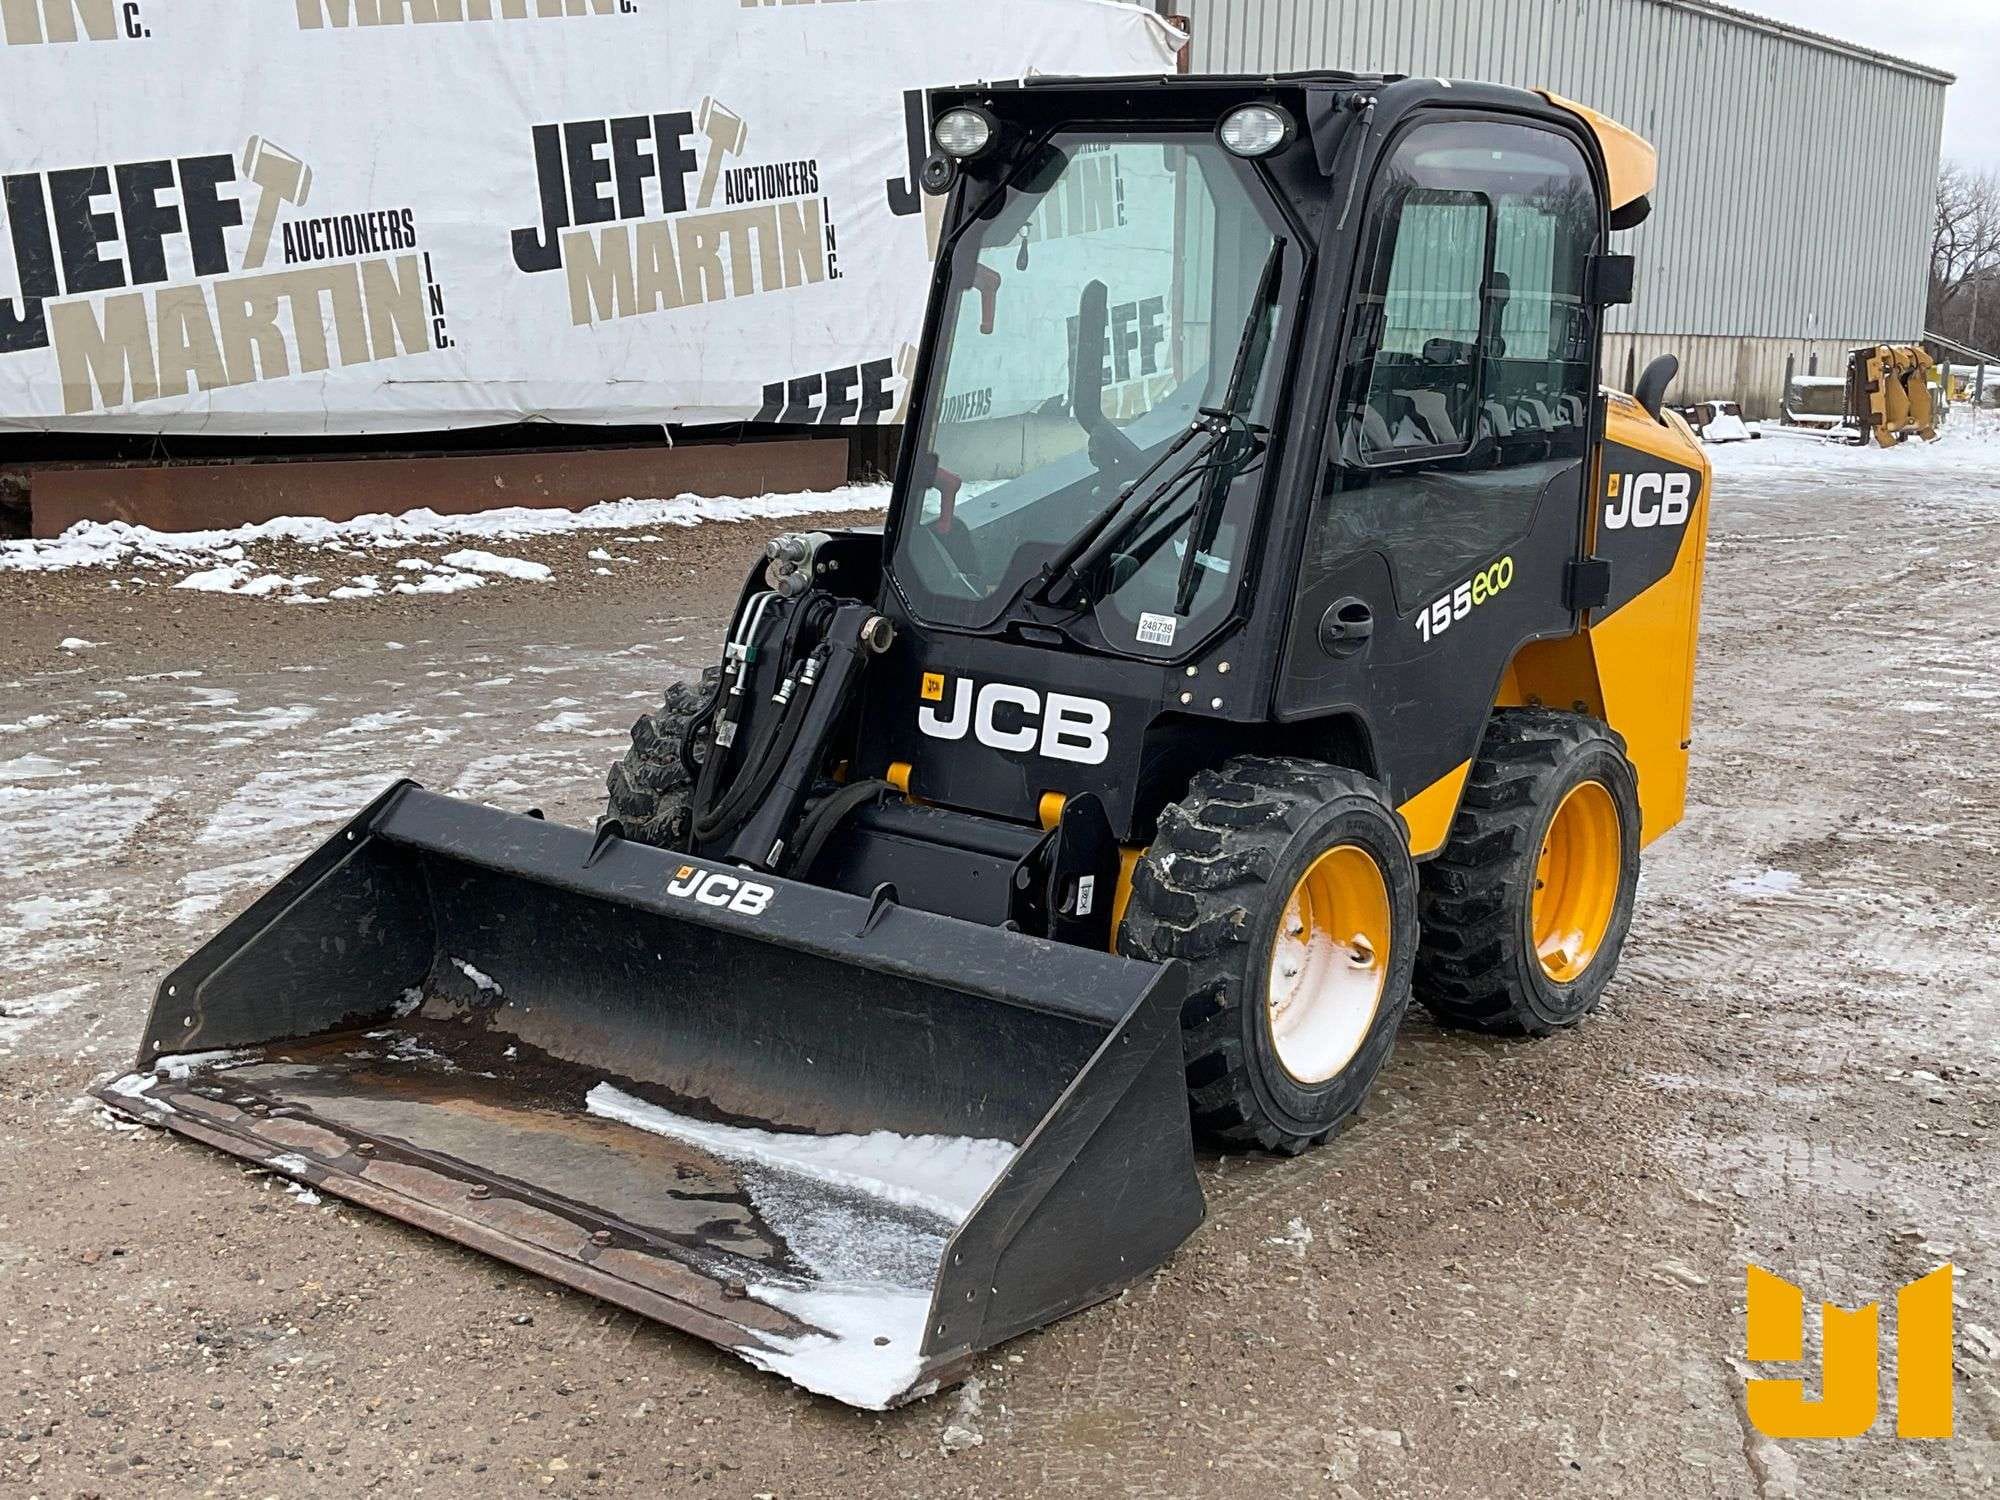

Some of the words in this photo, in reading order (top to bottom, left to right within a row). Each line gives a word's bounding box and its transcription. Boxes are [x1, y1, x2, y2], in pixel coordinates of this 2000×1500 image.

[511, 111, 698, 273] JEFF
[725, 159, 818, 205] AUCTIONEERS
[0, 154, 243, 353] JEFF
[282, 207, 417, 264] AUCTIONEERS
[562, 199, 824, 326] MARTIN
[50, 254, 430, 415] MARTIN
[424, 252, 455, 348] INC.
[1605, 473, 1691, 529] JCB
[1141, 619, 1173, 634] 248739
[1415, 556, 1513, 642] 155eco
[919, 677, 1111, 765] JCB
[667, 869, 775, 915] JCB
